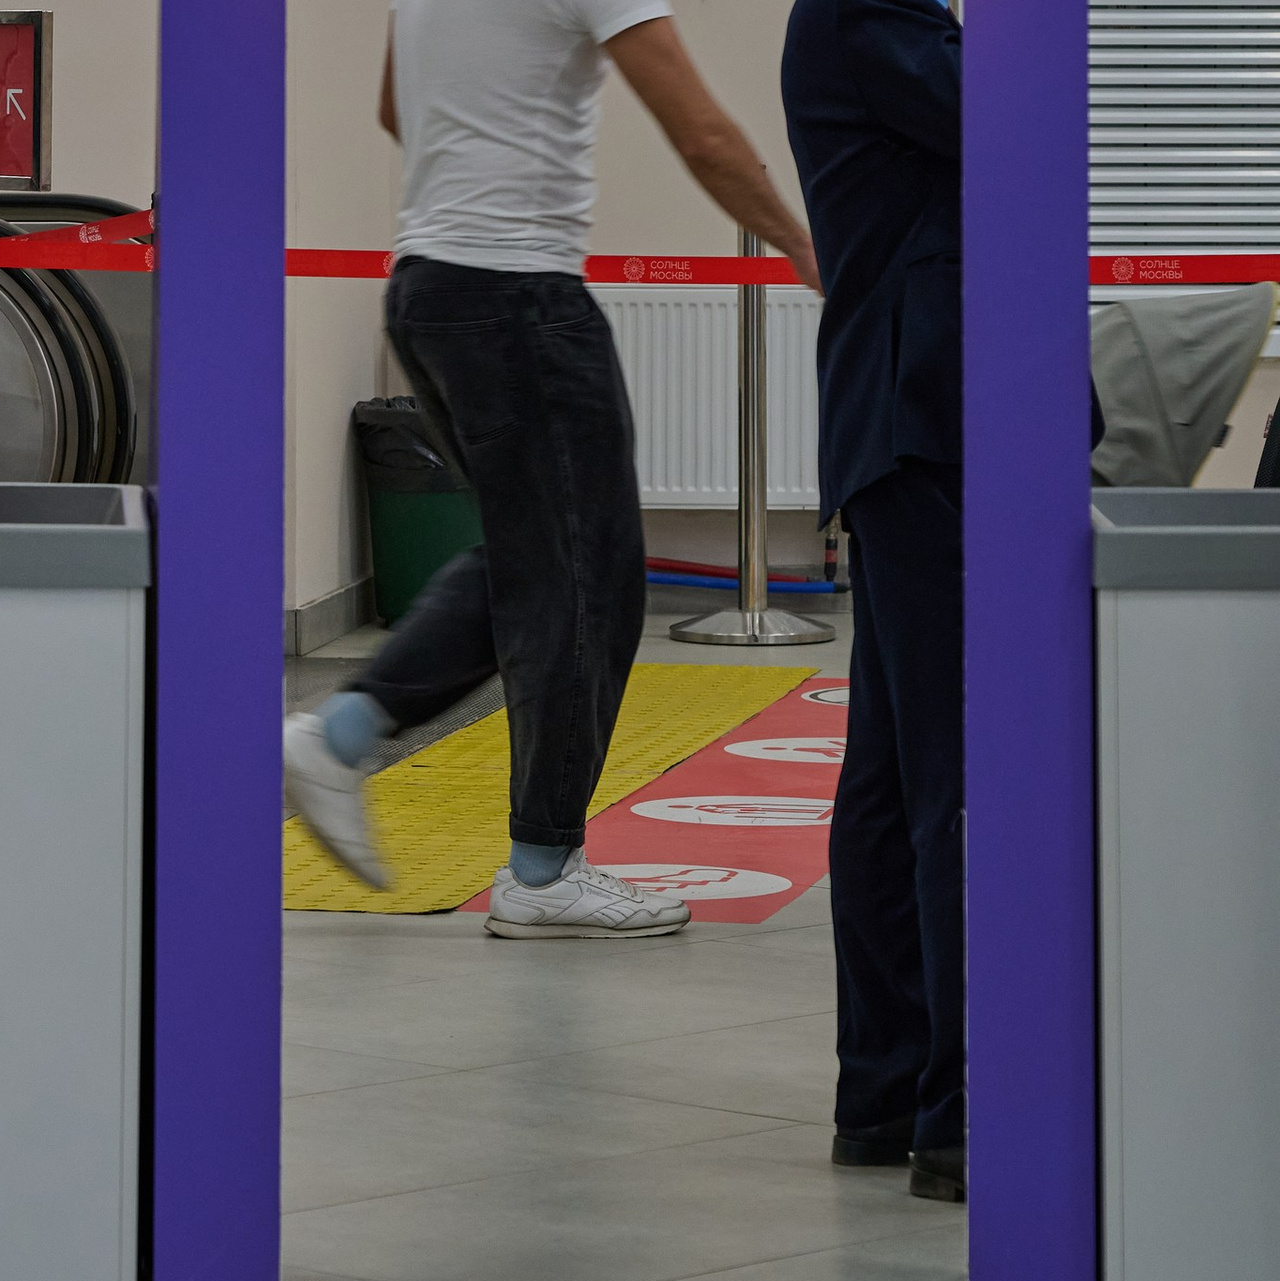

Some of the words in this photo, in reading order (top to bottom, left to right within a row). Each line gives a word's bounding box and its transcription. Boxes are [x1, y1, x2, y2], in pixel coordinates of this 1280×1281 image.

[650, 260, 691, 271] СОЛНЦЕ
[1139, 259, 1181, 269] СОЛНЦЕ
[650, 271, 693, 281] МОСКВЫ
[1139, 270, 1183, 280] МОСКВЫ
